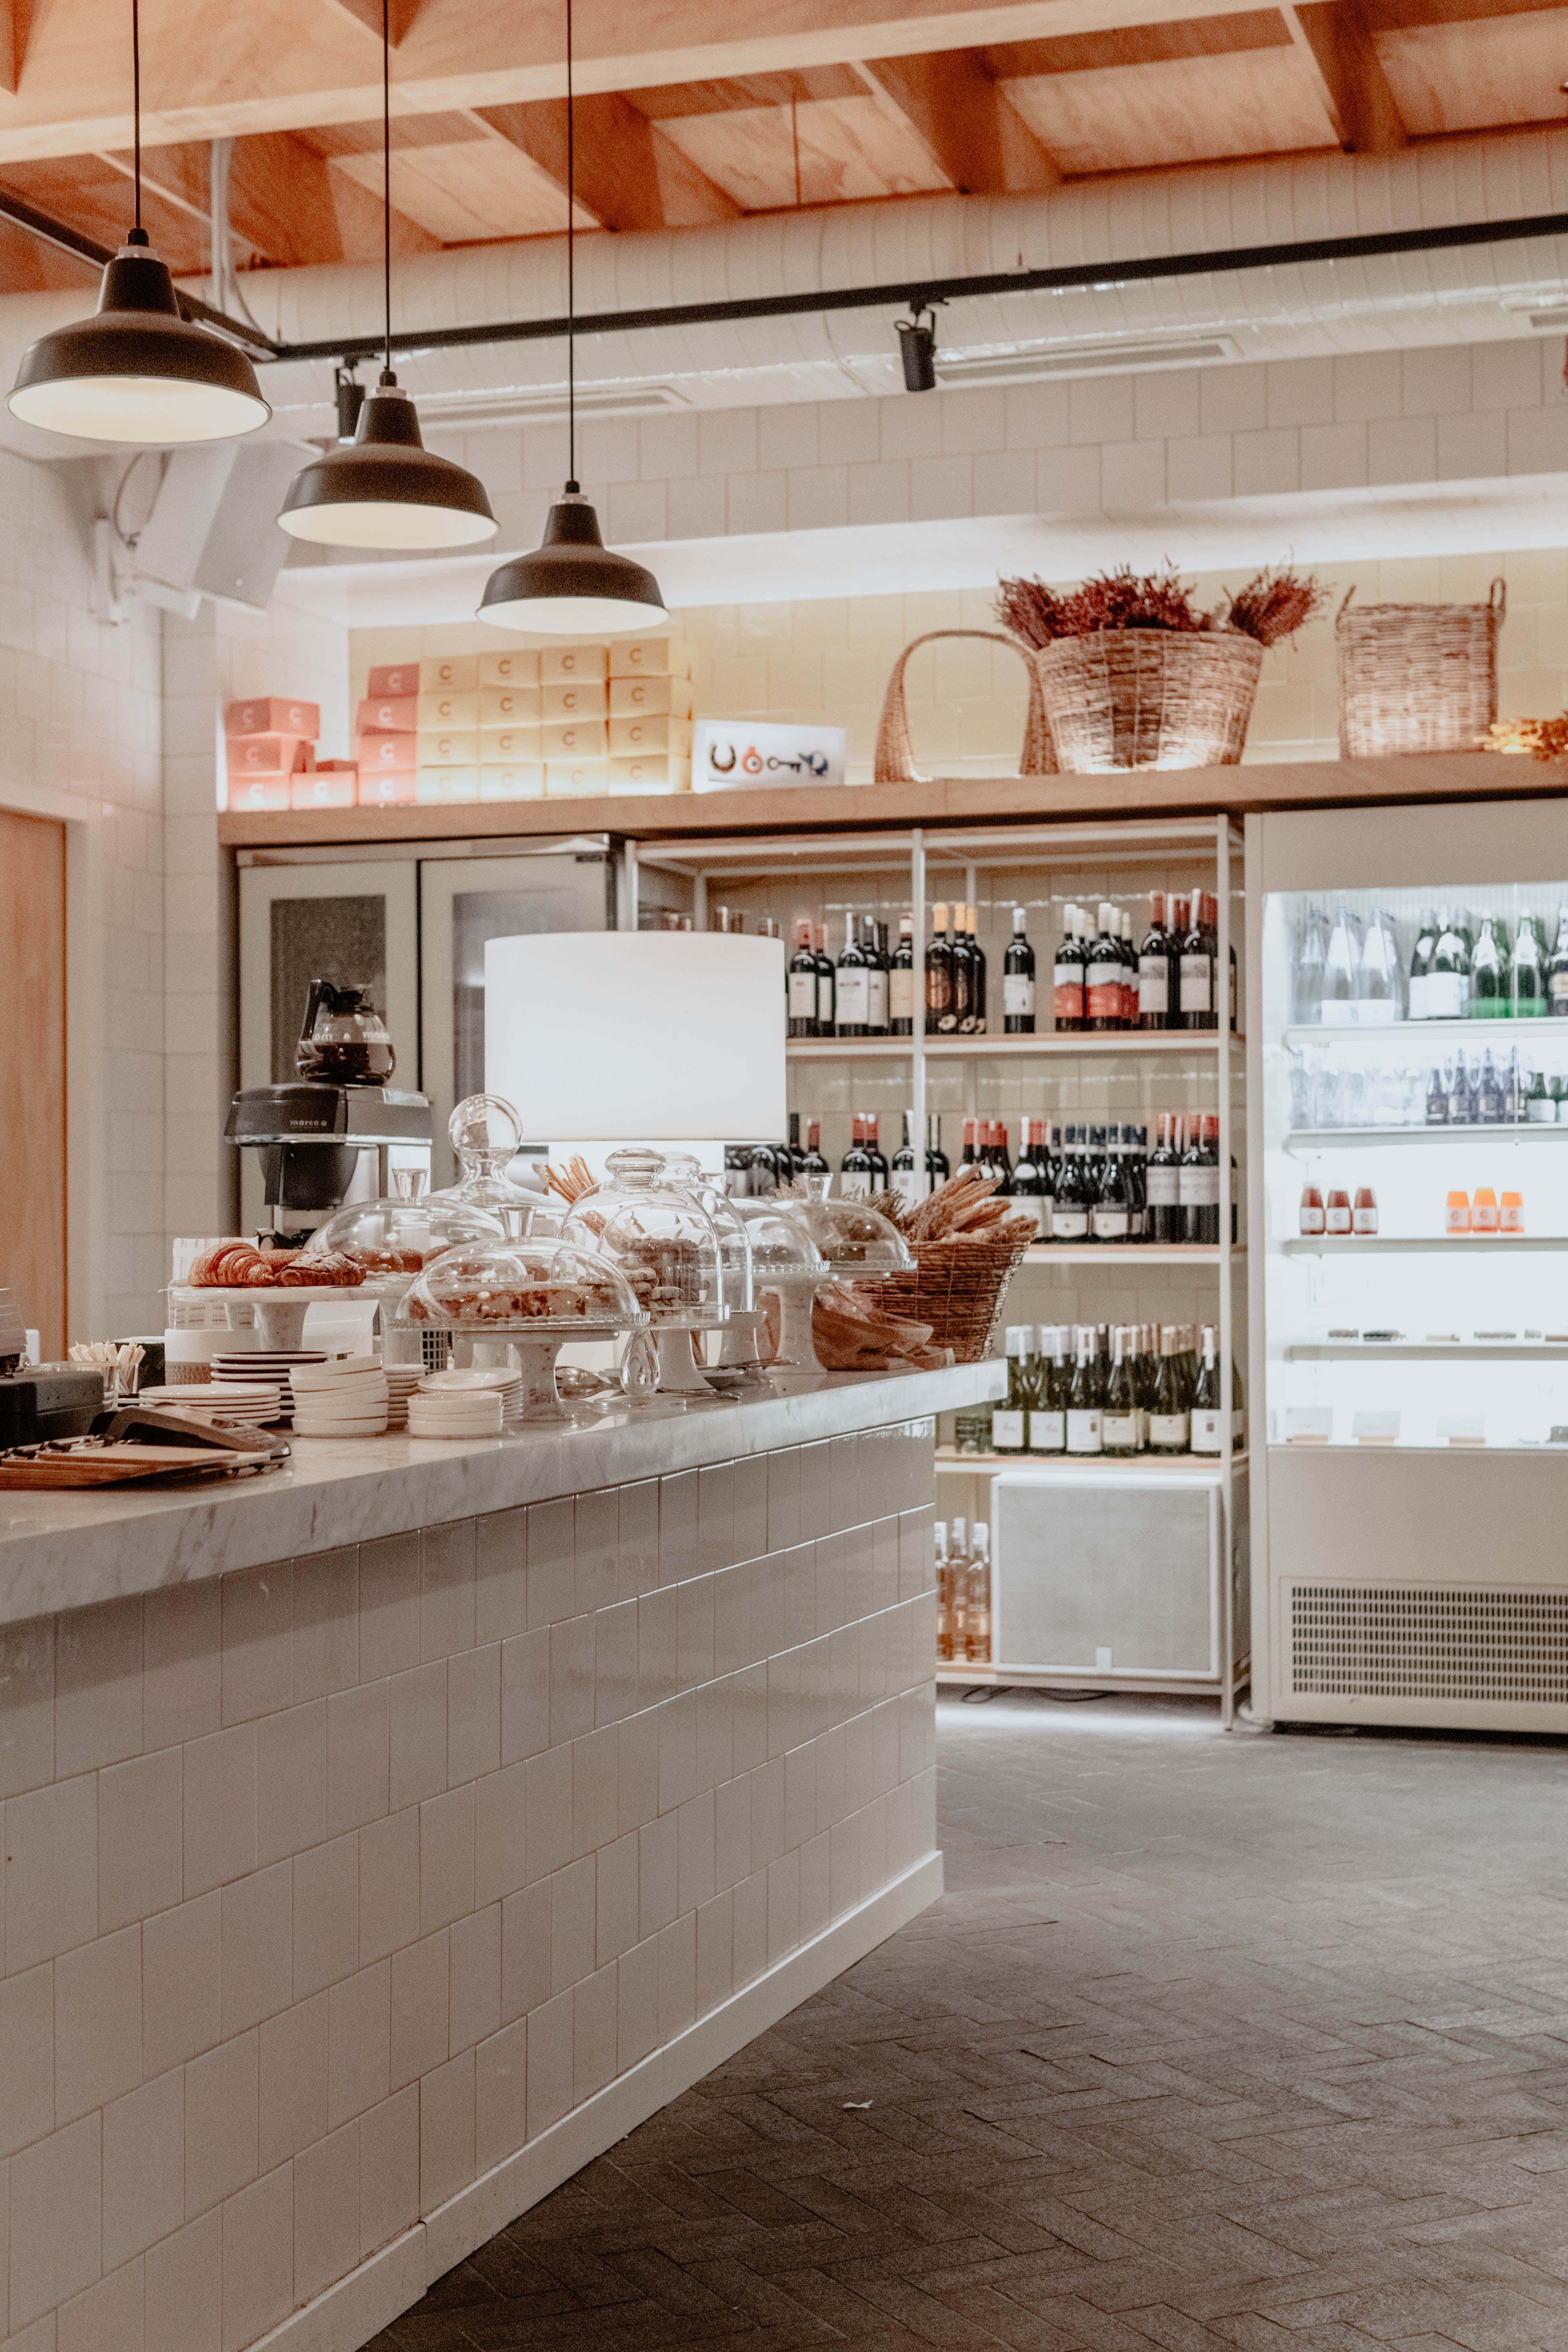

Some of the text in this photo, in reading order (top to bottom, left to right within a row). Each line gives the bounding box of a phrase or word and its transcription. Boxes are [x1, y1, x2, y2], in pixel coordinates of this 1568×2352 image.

[562, 655, 575, 670] C
[630, 648, 641, 663] C
[440, 665, 452, 681] C
[499, 659, 511, 674] C
[563, 693, 576, 708] C
[631, 687, 644, 702] C
[440, 702, 451, 716] C
[501, 697, 512, 711] C
[500, 735, 512, 749] C
[562, 731, 575, 746] C
[629, 727, 641, 742] C
[438, 739, 451, 753] C
